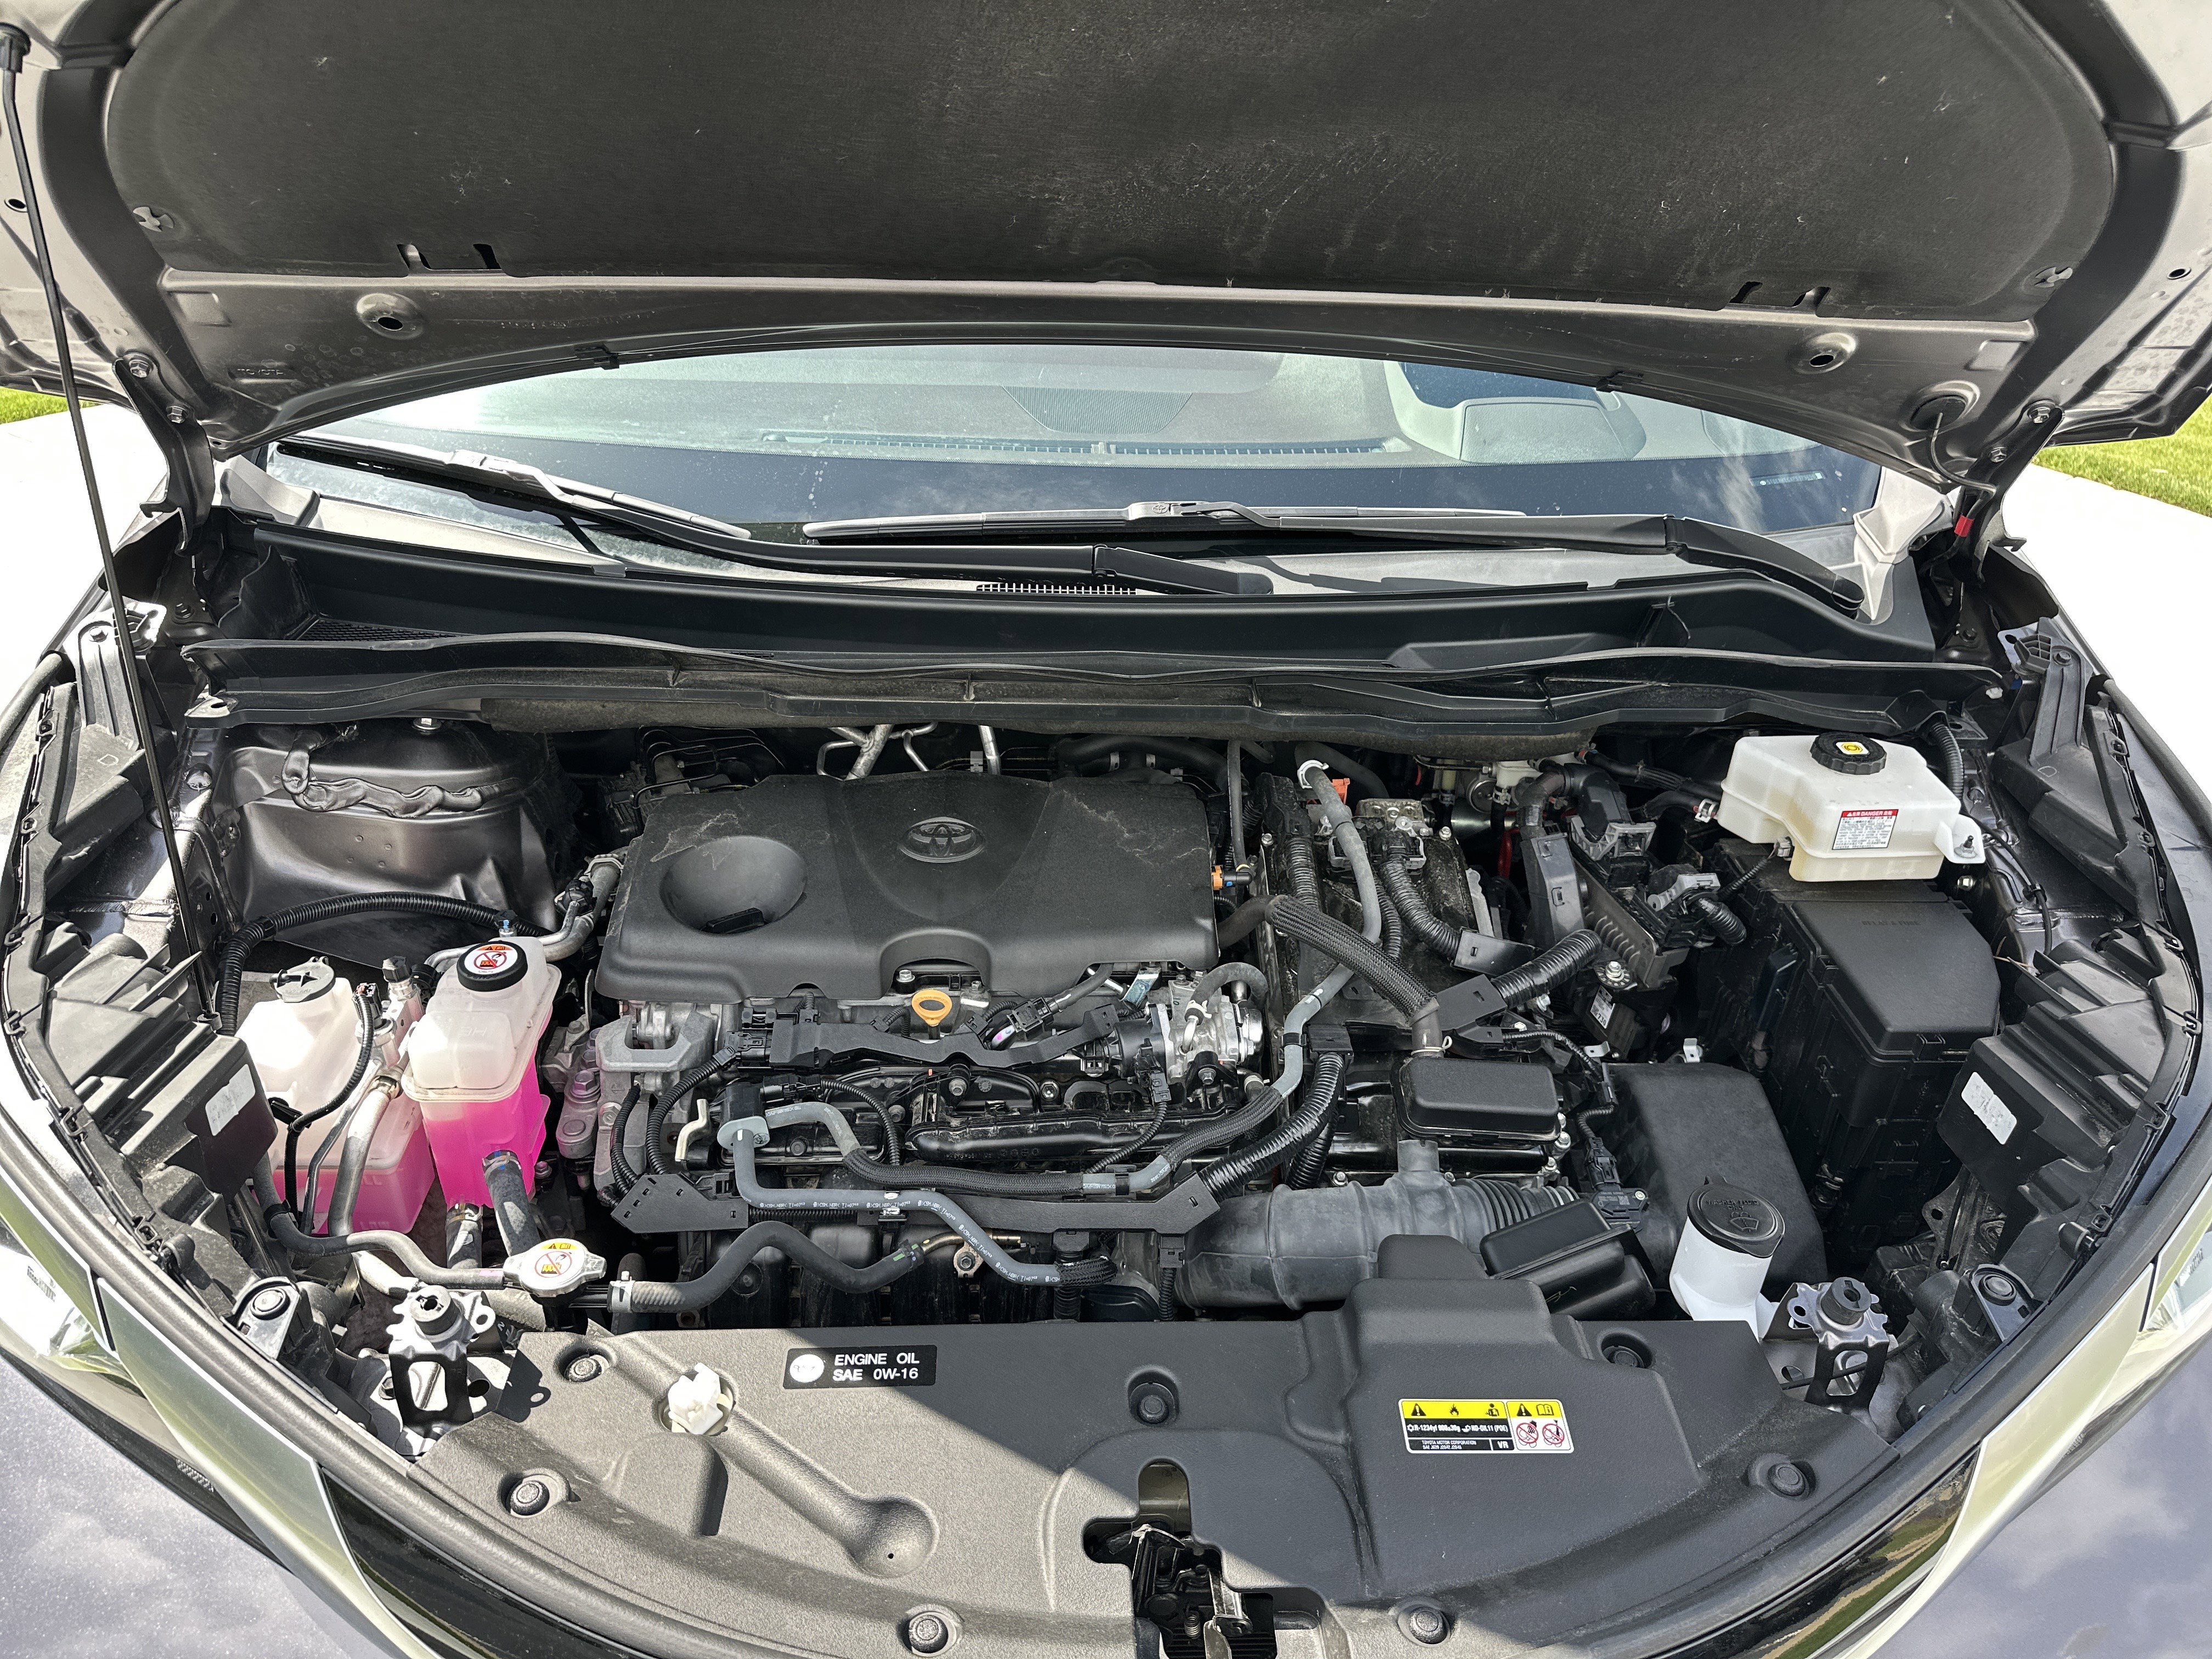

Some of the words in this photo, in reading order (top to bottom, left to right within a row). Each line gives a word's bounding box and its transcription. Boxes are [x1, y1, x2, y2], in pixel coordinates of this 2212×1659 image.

[834, 1353, 887, 1366] ENGINE
[896, 1352, 919, 1364] OIL
[832, 1368, 863, 1381] SAE
[873, 1367, 918, 1380] 0W-16
[1497, 1441, 1509, 1449] VR
